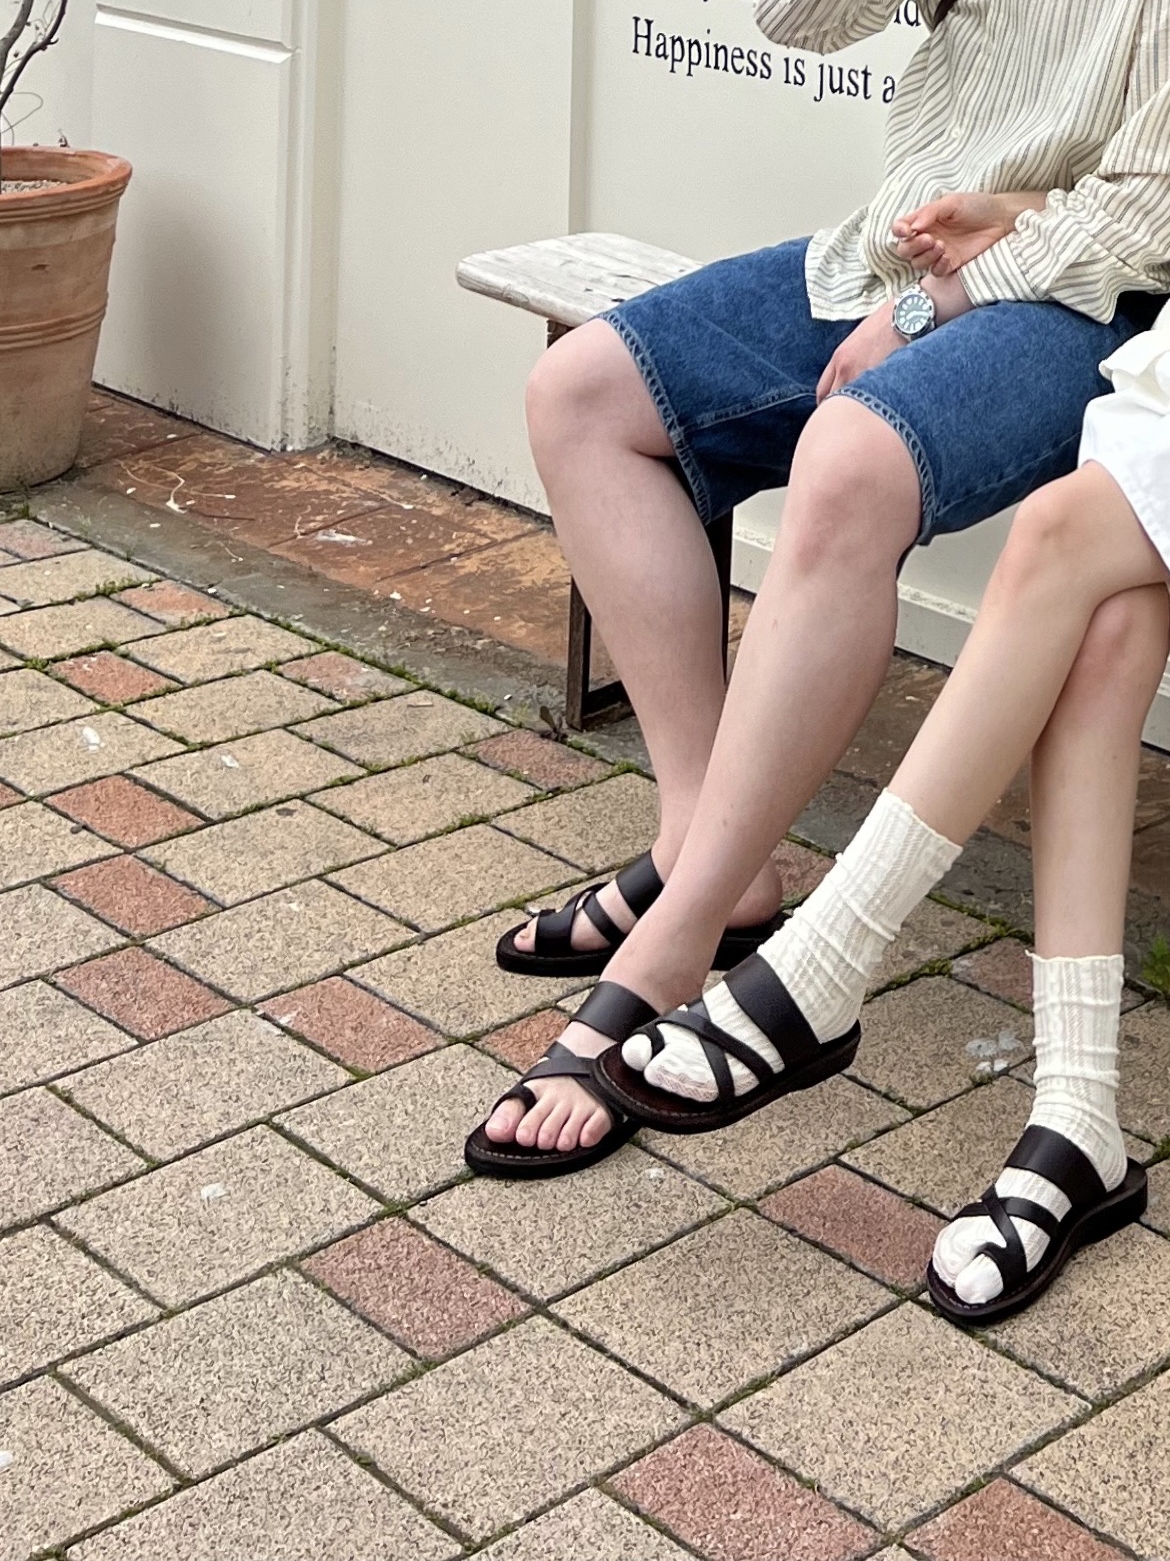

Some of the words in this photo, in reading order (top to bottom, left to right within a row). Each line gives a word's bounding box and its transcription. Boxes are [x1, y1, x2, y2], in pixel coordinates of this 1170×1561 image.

[632, 15, 773, 79] Happiness
[783, 57, 806, 87] is
[813, 63, 872, 103] just
